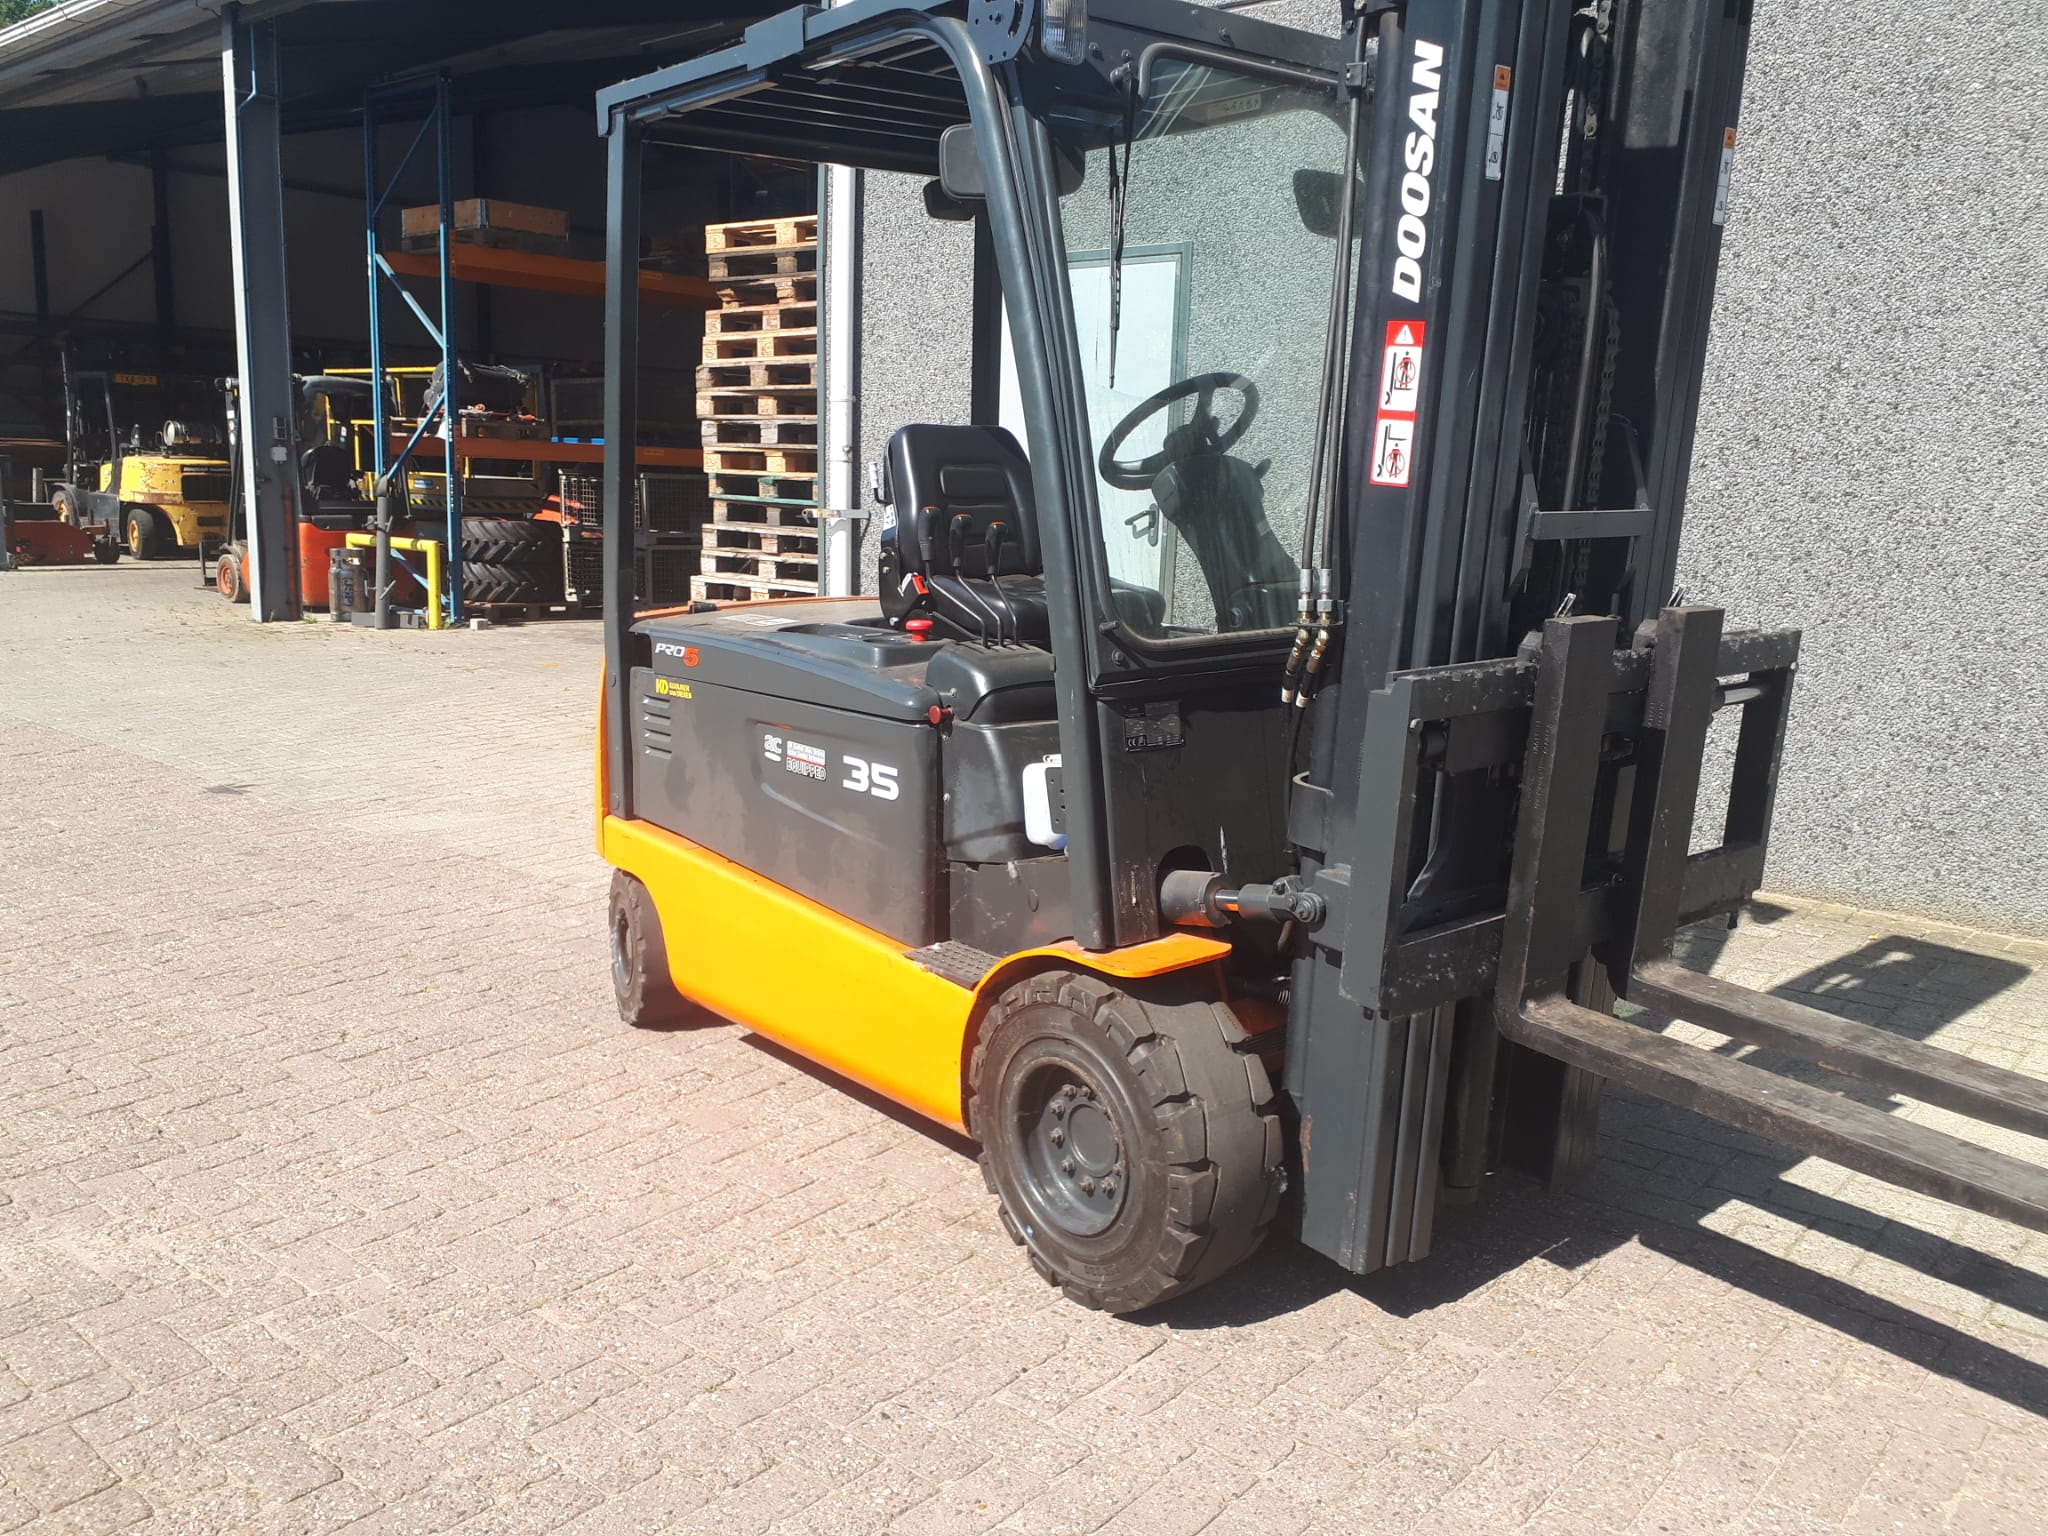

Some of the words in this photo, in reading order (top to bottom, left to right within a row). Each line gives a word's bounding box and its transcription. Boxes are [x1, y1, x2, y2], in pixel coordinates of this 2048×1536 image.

[1392, 39, 1444, 304] DOOSAN
[785, 756, 827, 781] EQUIPPED
[842, 754, 900, 801] 35
